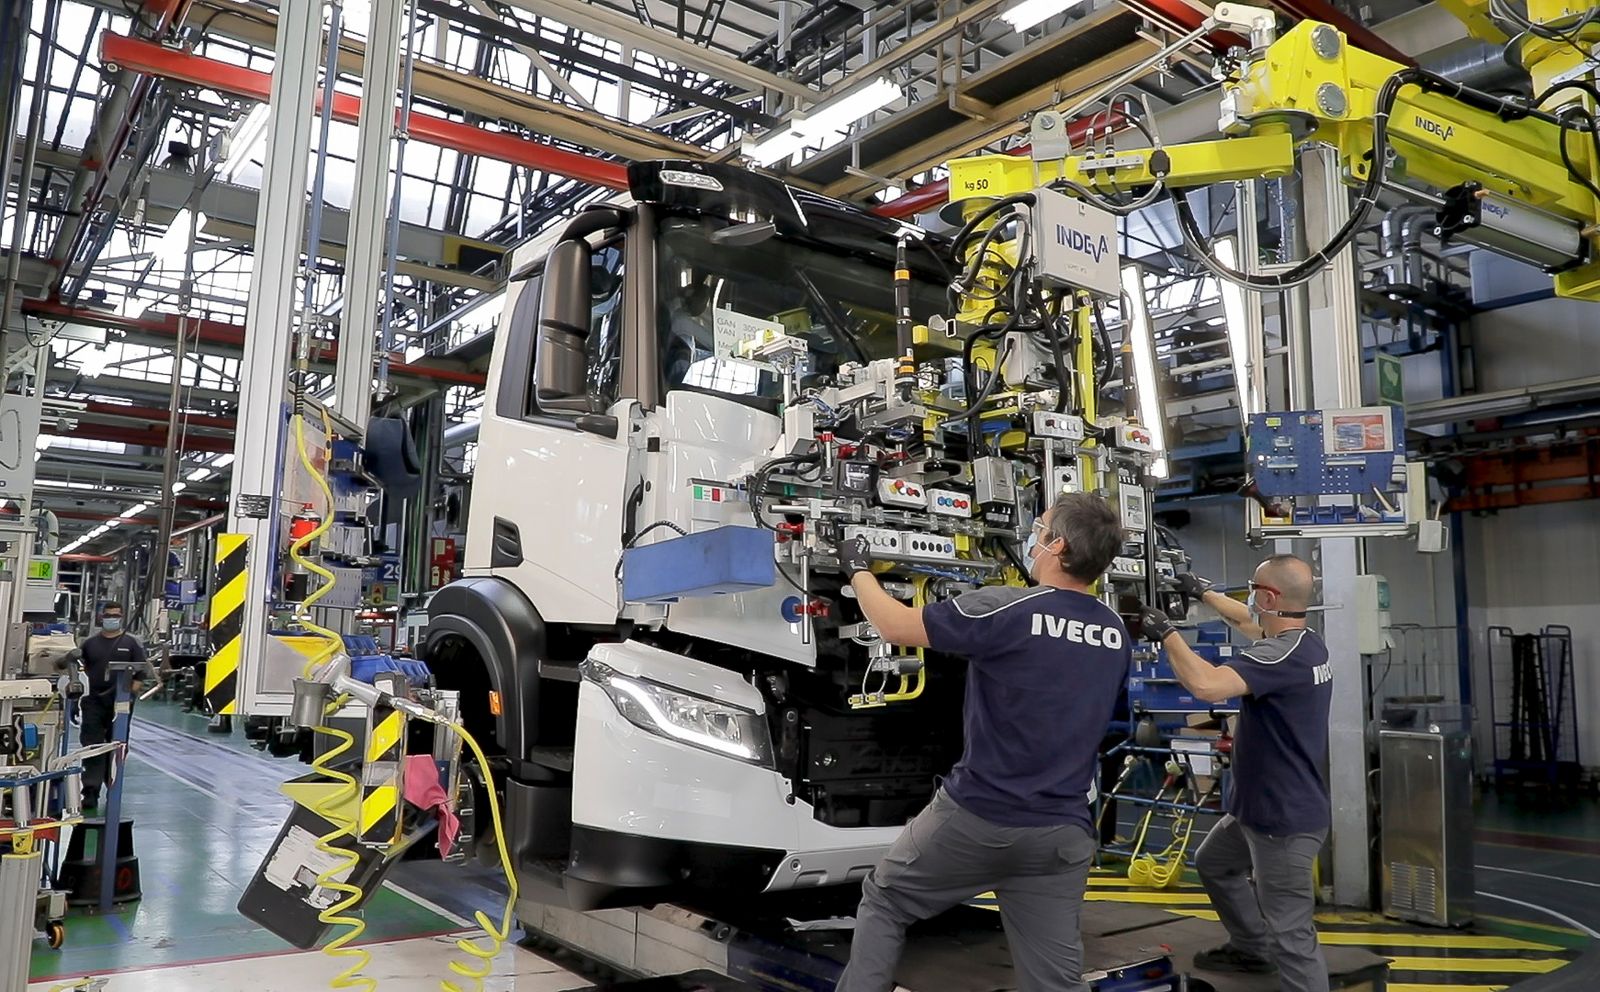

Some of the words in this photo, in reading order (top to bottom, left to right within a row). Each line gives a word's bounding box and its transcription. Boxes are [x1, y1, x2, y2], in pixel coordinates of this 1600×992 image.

[1415, 115, 1454, 141] INDEVA
[964, 181, 975, 191] kg
[976, 178, 989, 190] 50
[1056, 223, 1109, 264] INDEVA
[166, 599, 181, 609] 27
[1031, 613, 1122, 650] IVECO
